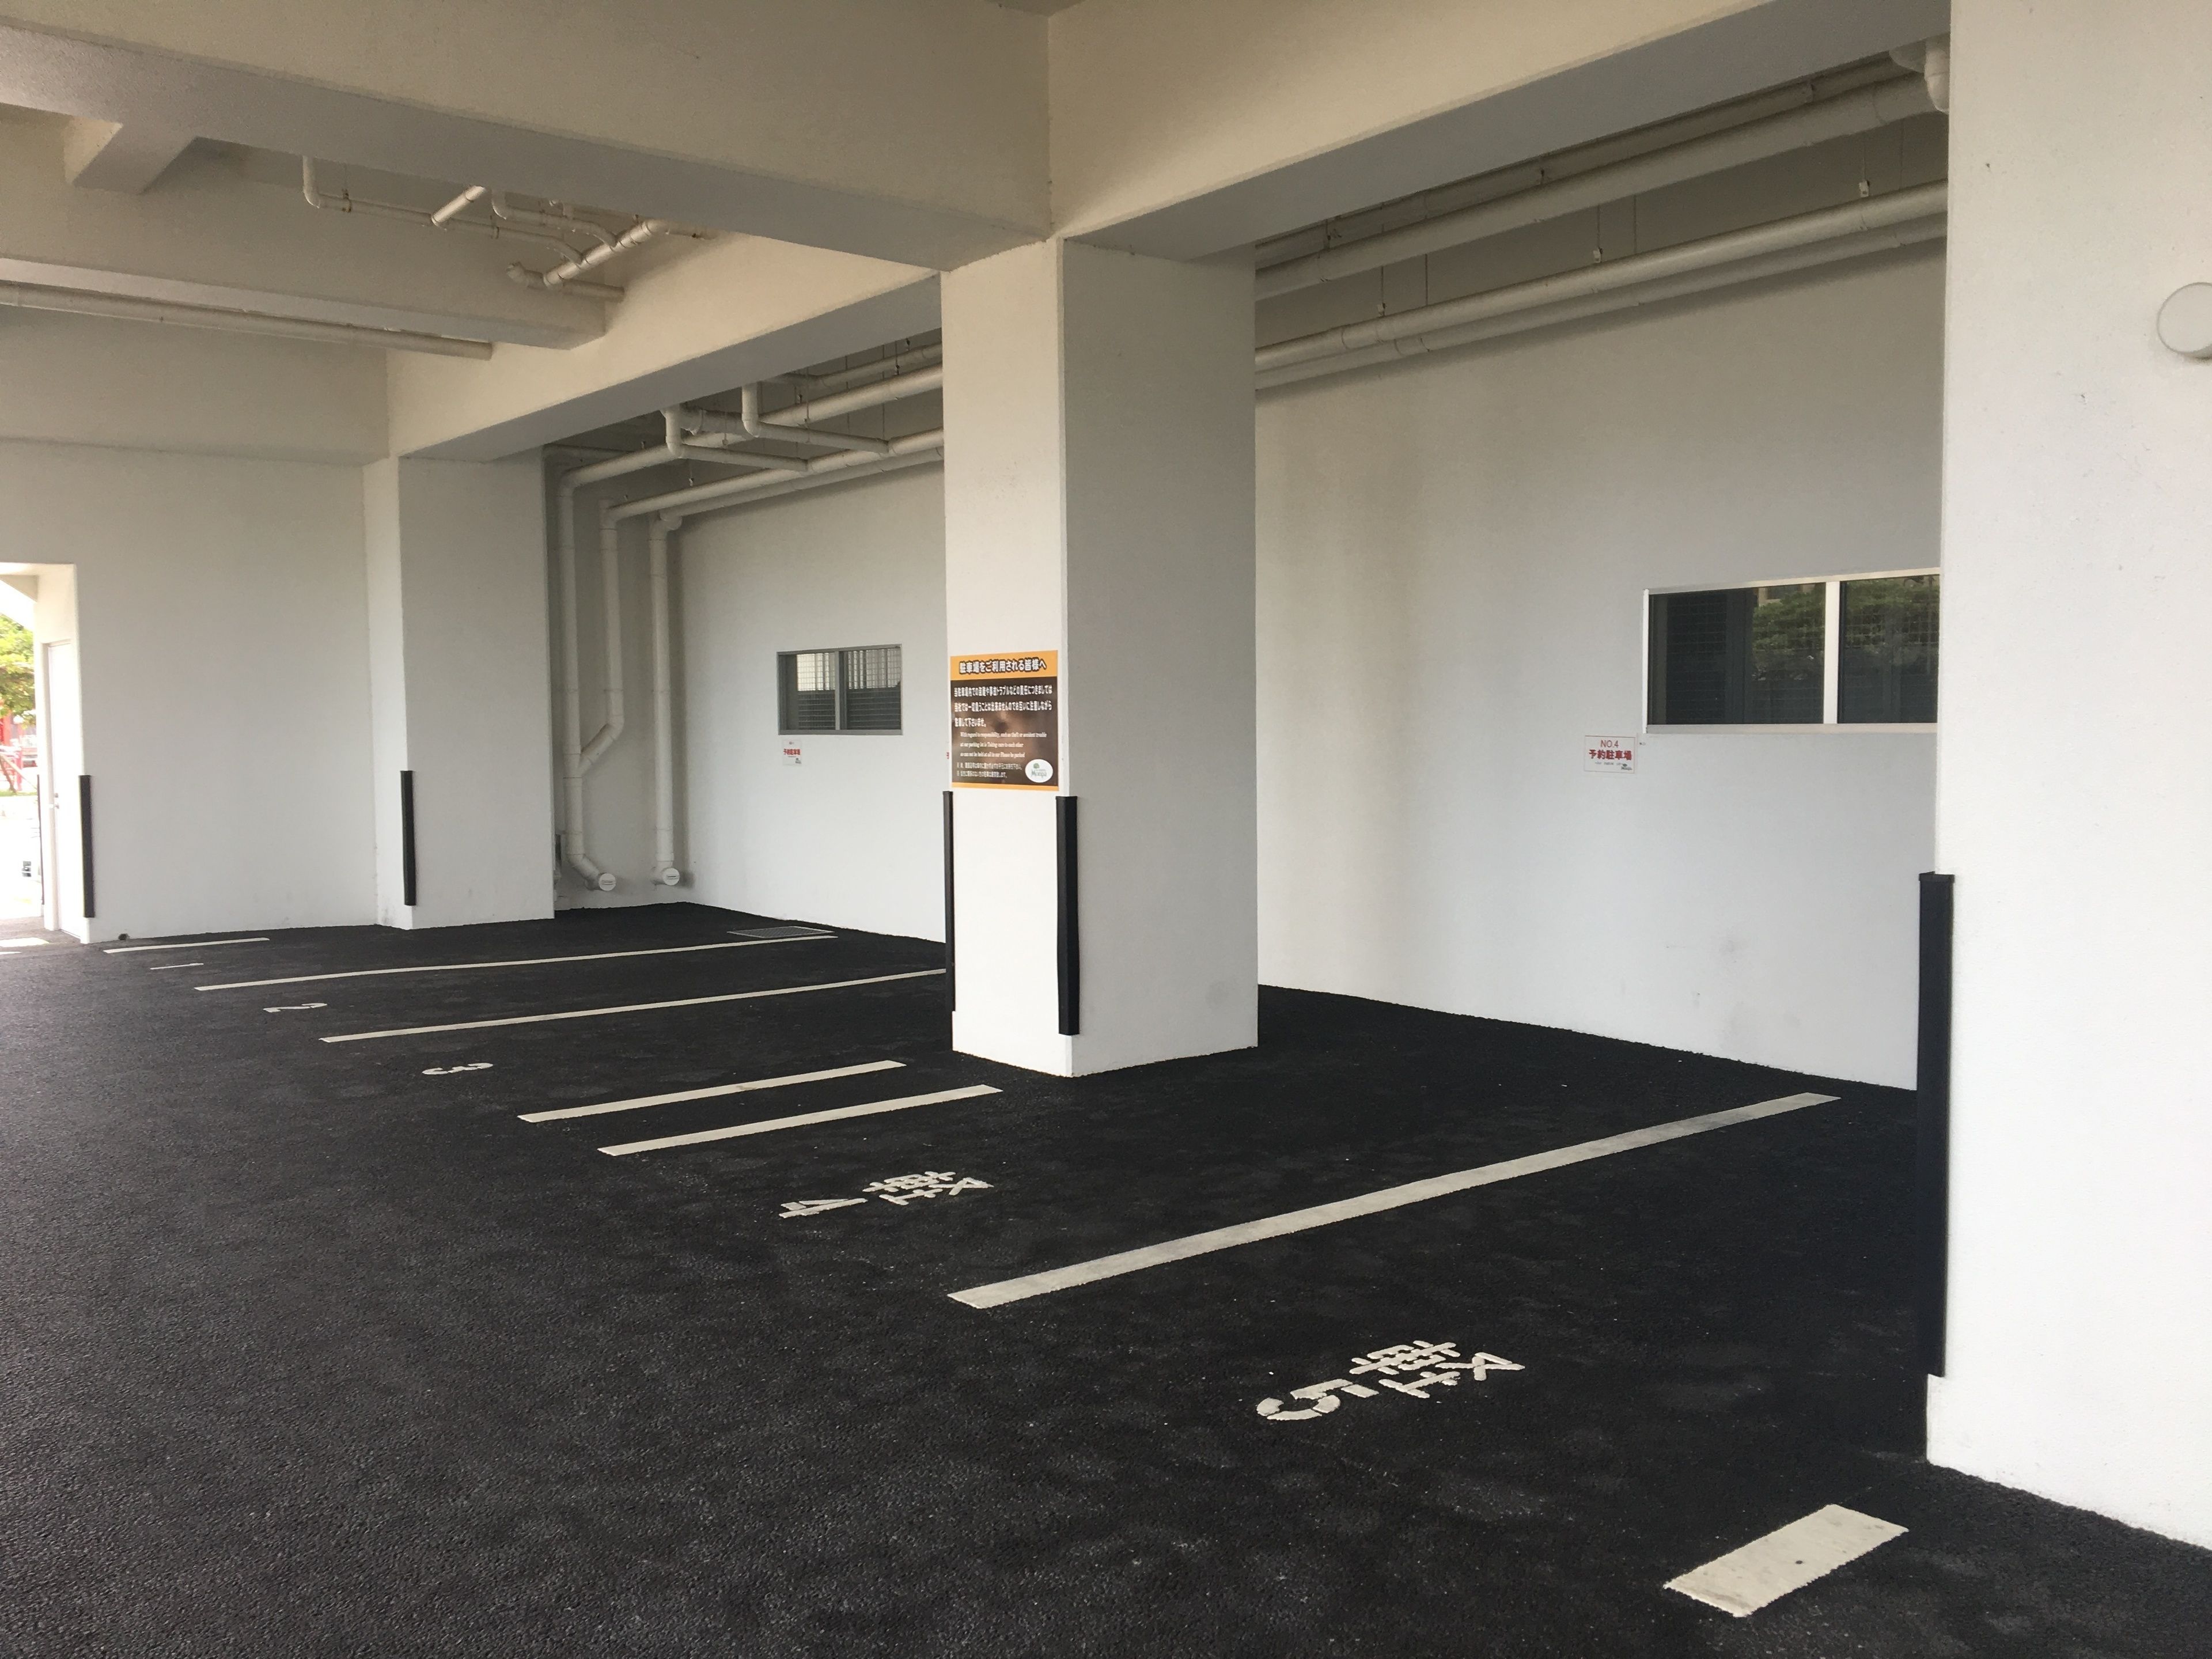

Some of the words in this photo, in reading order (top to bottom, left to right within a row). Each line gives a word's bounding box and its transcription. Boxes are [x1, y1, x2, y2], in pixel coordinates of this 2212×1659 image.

[959, 657, 1047, 675] 駐車場をご利用される皆様へ
[1600, 740, 1619, 748] NO.4
[1589, 749, 1632, 760] 予約駐車場
[422, 1062, 493, 1075] 3
[779, 1198, 868, 1218] 4
[1256, 1378, 1379, 1421] 5
